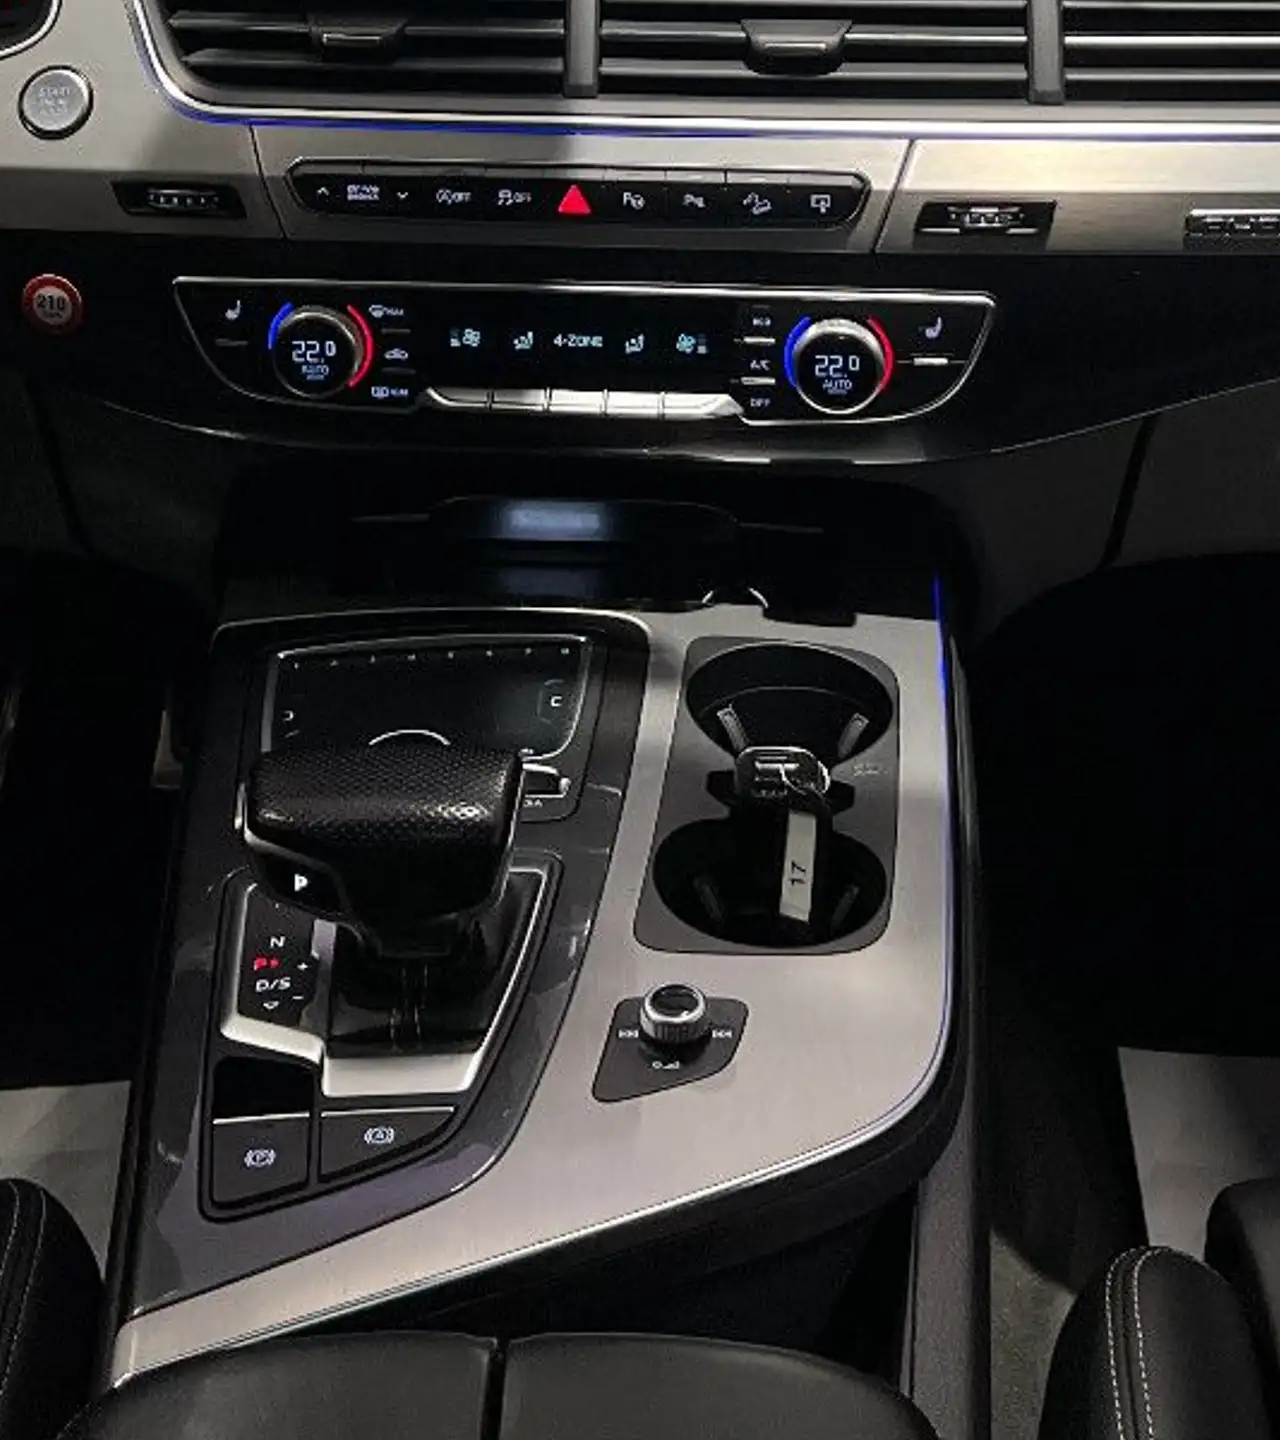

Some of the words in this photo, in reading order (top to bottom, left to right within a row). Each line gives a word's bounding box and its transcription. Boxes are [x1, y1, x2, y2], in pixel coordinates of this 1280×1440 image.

[35, 293, 67, 311] 210
[552, 333, 603, 348] 4-ZONE
[822, 378, 853, 390] AUTO
[790, 860, 807, 887] 17
[294, 873, 309, 892] P
[270, 935, 286, 948] N
[255, 976, 292, 993] D/S
